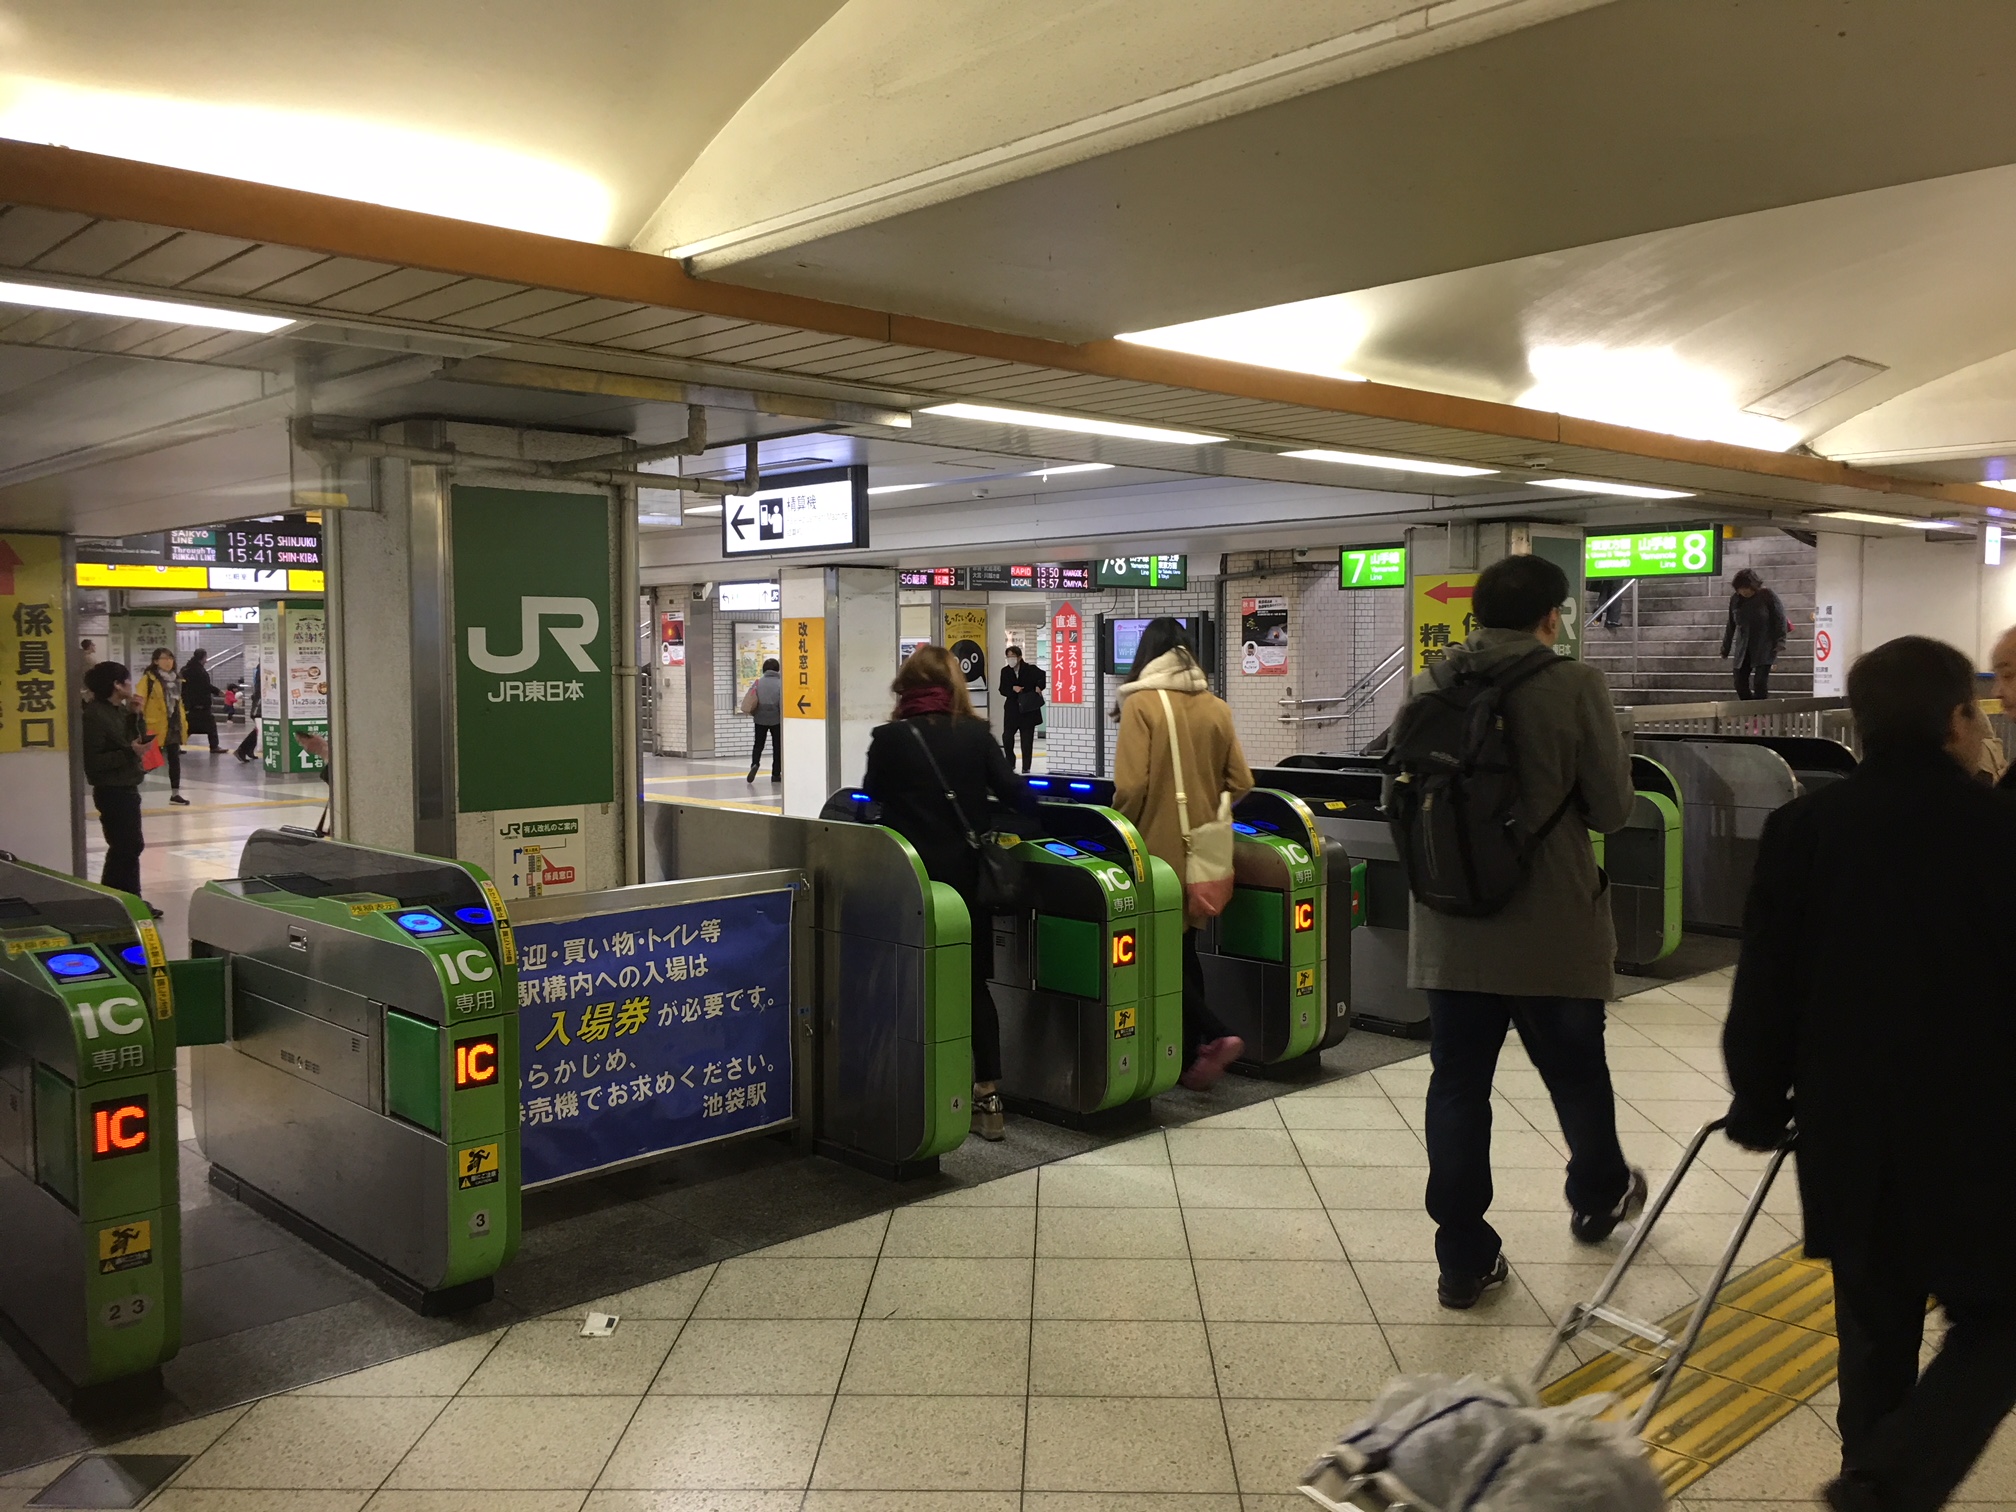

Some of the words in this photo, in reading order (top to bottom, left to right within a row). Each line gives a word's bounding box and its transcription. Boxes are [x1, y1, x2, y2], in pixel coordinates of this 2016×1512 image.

[171, 537, 194, 545] LINE
[172, 546, 206, 554] Through
[227, 532, 275, 548] 15:45
[277, 535, 317, 548] SHINJUKU
[1682, 533, 1707, 570] 8
[172, 553, 199, 561] RINKAI
[200, 554, 216, 562] LINE
[227, 548, 273, 563] 15:41
[277, 552, 319, 564] SHIN-KIBA
[1660, 561, 1677, 569] Line
[1011, 567, 1032, 577] RAPID
[1036, 567, 1059, 578] 15:50
[1083, 569, 1088, 579] 4
[1348, 553, 1366, 584] 7
[1010, 578, 1032, 587] LOCAL
[1036, 578, 1059, 589] 15:57
[1083, 580, 1088, 589] 4
[1055, 614, 1078, 628] 直進
[467, 595, 601, 675] JR
[798, 621, 808, 685] 改札窓口
[12, 602, 56, 748] 係員窓口
[1055, 645, 1064, 702] エレベーター
[1068, 645, 1078, 702] エスカレーター
[487, 679, 585, 703] JR東日本
[500, 823, 520, 836] JR
[523, 822, 578, 834] 有人改札のご案内
[1278, 843, 1309, 866] IC
[544, 870, 573, 881] 係員窓口
[1096, 867, 1131, 893] IC
[1295, 869, 1312, 883] 専用
[1113, 895, 1135, 913] 専用
[1294, 903, 1312, 930] IC
[1112, 934, 1133, 964] IC
[439, 949, 493, 985] IC
[518, 953, 709, 1007] 駅構内への入場は
[454, 989, 495, 1014] 専用
[77, 997, 144, 1040] IC
[535, 995, 651, 1051] 入場券
[657, 984, 775, 1028] が必要です。
[1302, 1012, 1307, 1022] 5
[91, 1044, 144, 1072] 専用
[1121, 1056, 1127, 1067] 4
[1167, 1046, 1173, 1056] 5
[457, 1042, 495, 1085] IC
[702, 1081, 768, 1119] 池袋駅
[953, 1098, 959, 1109] 4
[95, 1105, 147, 1154] IC
[476, 1213, 486, 1227] 3
[109, 1304, 121, 1321] 2
[132, 1299, 144, 1314] 3
